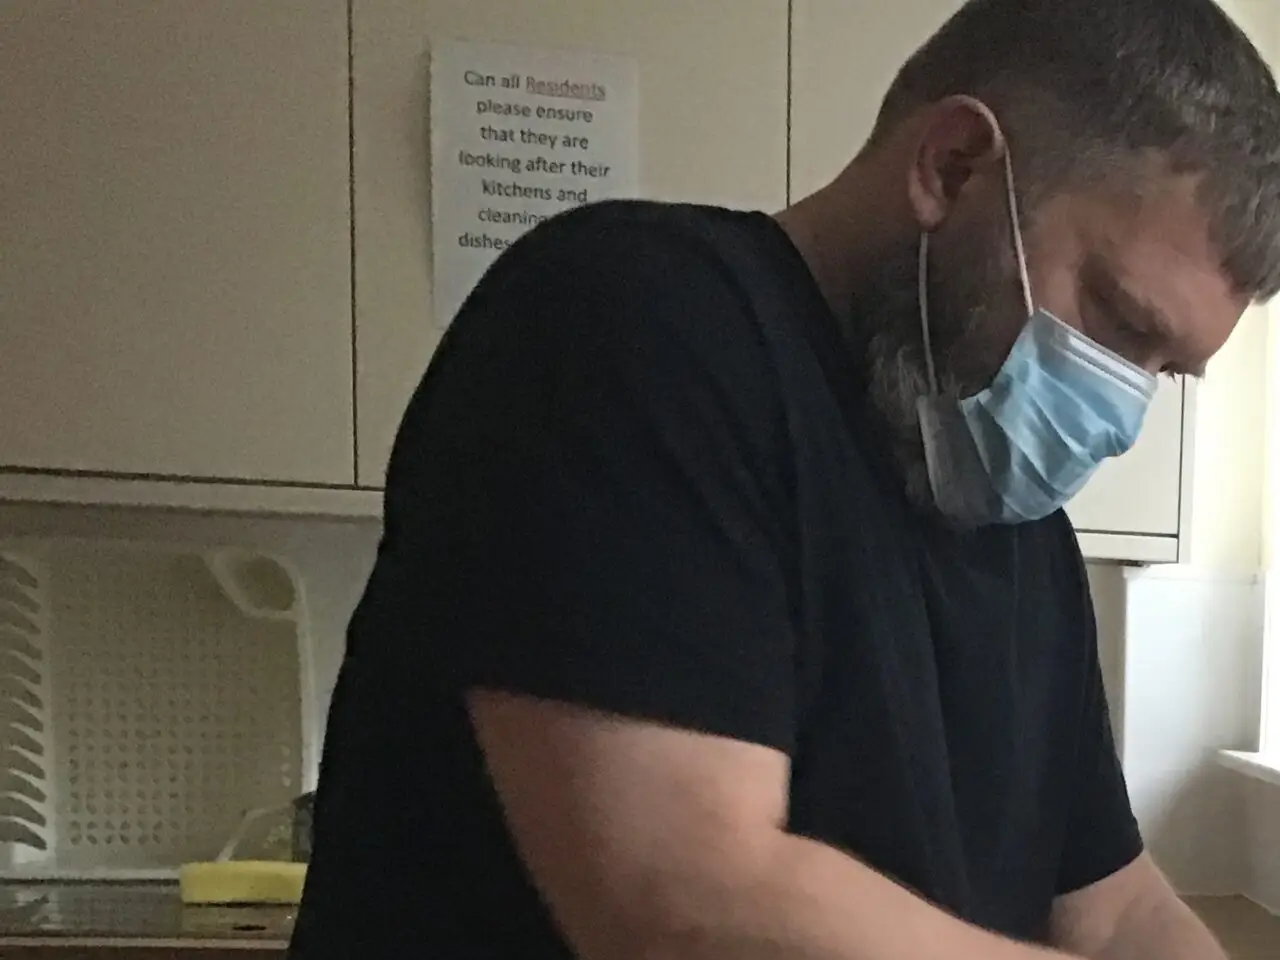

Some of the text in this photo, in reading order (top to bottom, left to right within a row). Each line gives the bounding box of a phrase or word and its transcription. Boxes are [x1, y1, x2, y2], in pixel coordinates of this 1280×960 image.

[464, 70, 606, 98] Can all Residents
[476, 99, 593, 123] please ensure
[480, 125, 589, 150] that they are
[458, 150, 611, 177] looking after their
[482, 179, 588, 202] kitchens and
